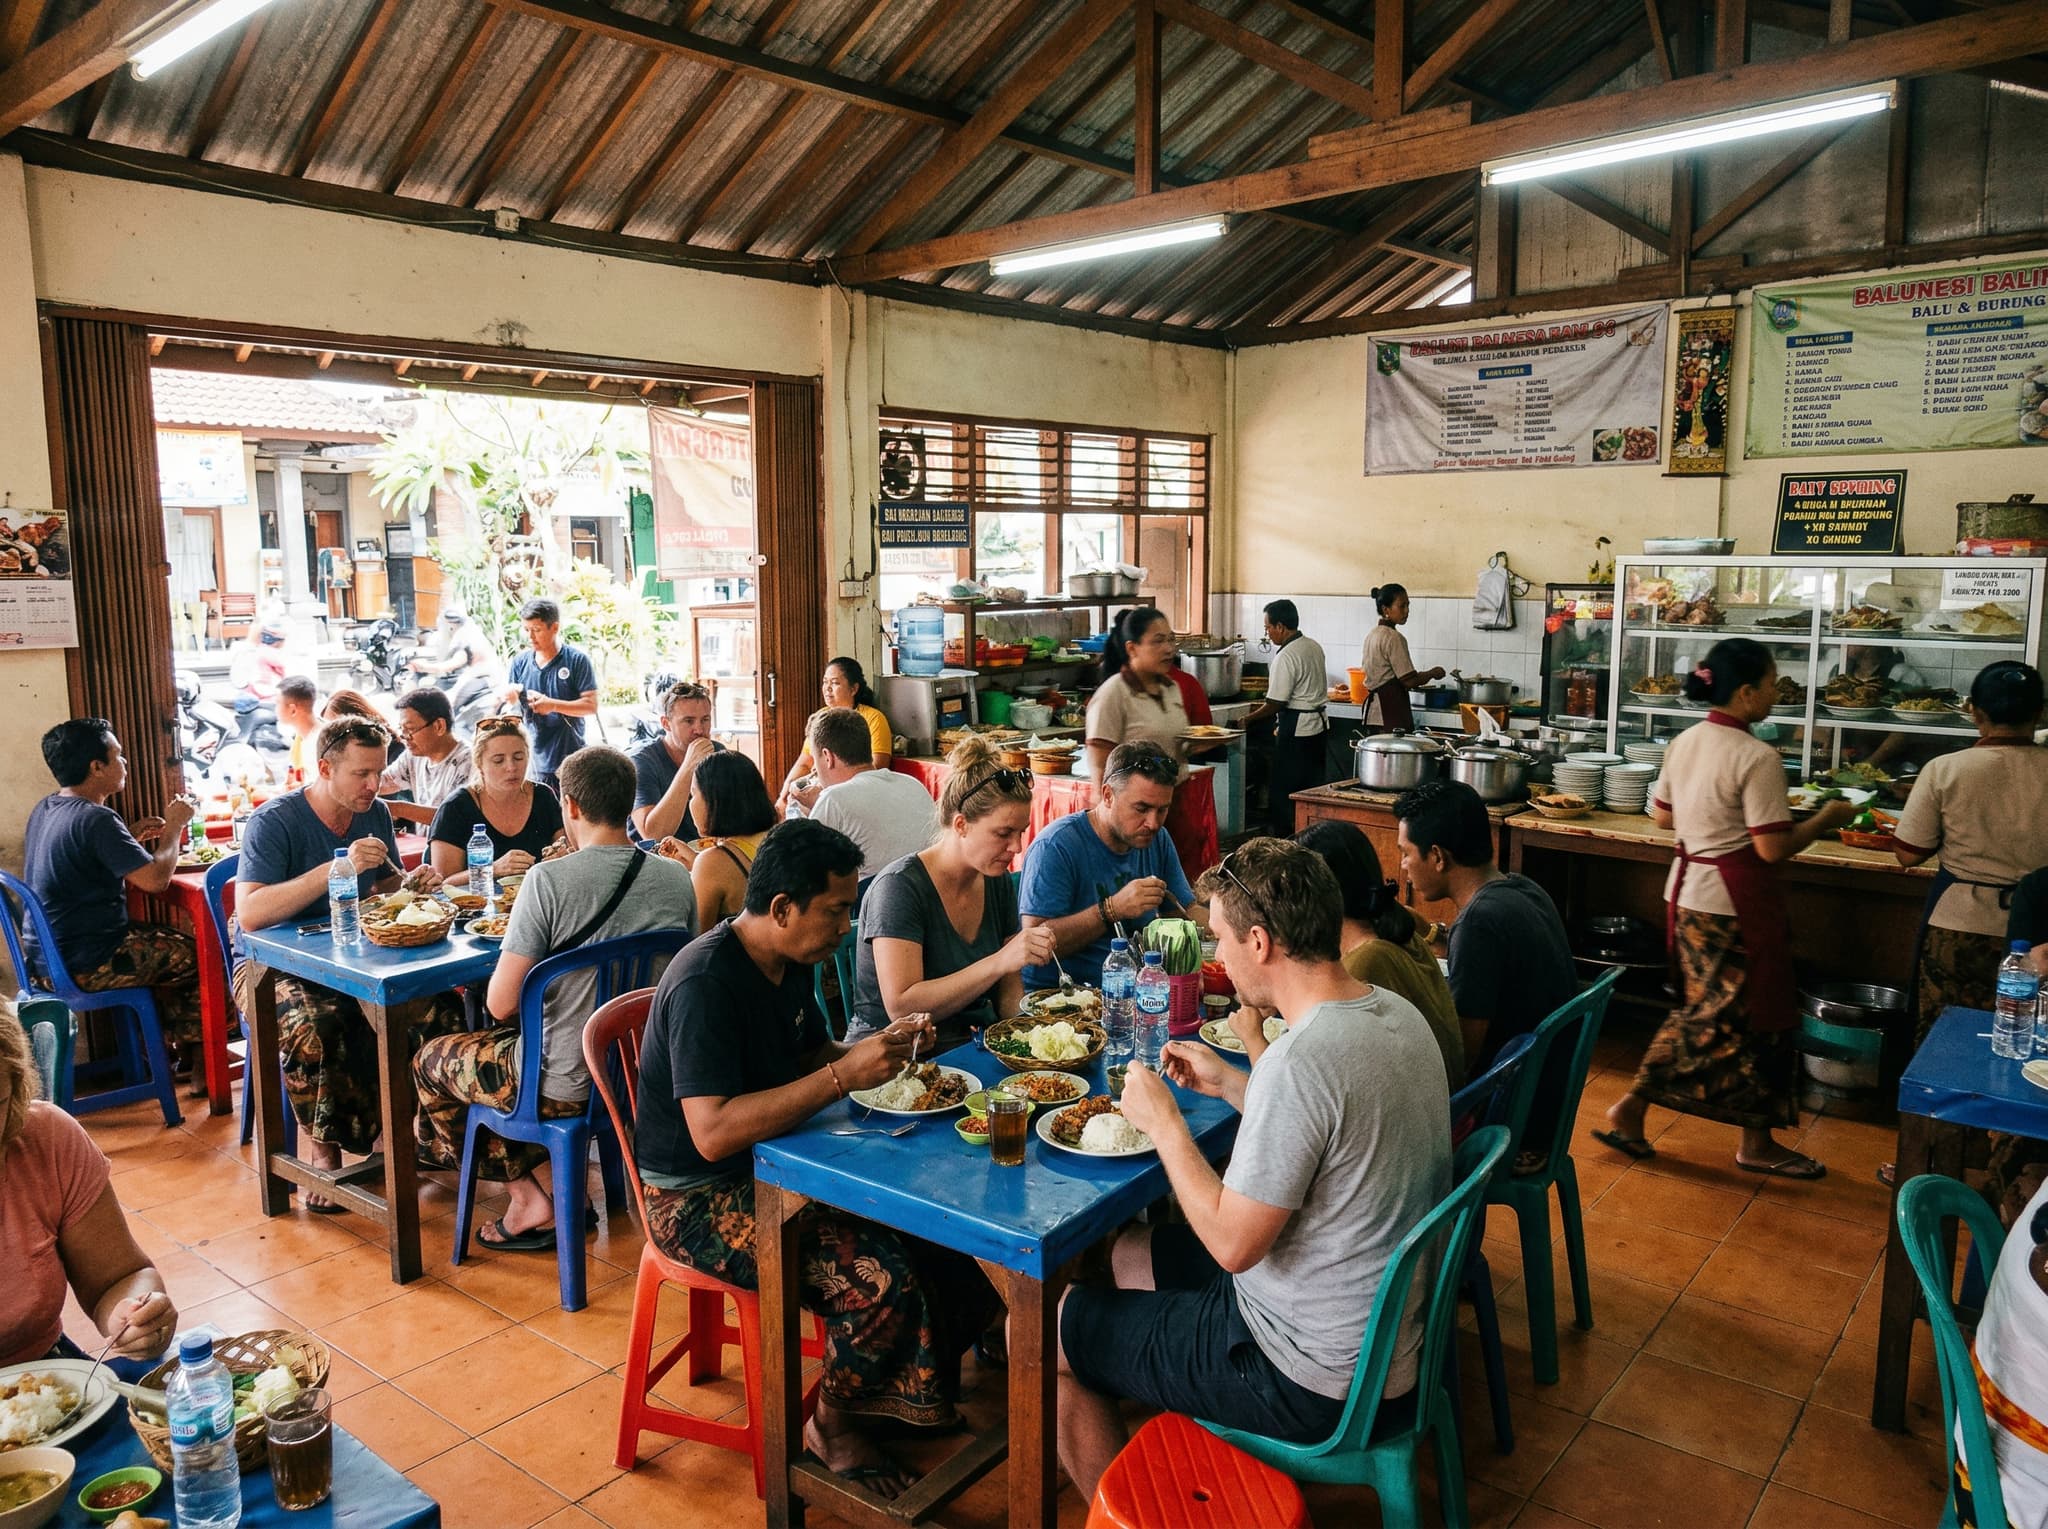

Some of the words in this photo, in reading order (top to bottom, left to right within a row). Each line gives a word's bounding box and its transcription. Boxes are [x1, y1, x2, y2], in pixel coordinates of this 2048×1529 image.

[1853, 276, 1976, 307] BALUNESI
[1912, 303, 1952, 318] BALU
[1958, 301, 1971, 314] &
[1978, 294, 2046, 312] BURUNG
